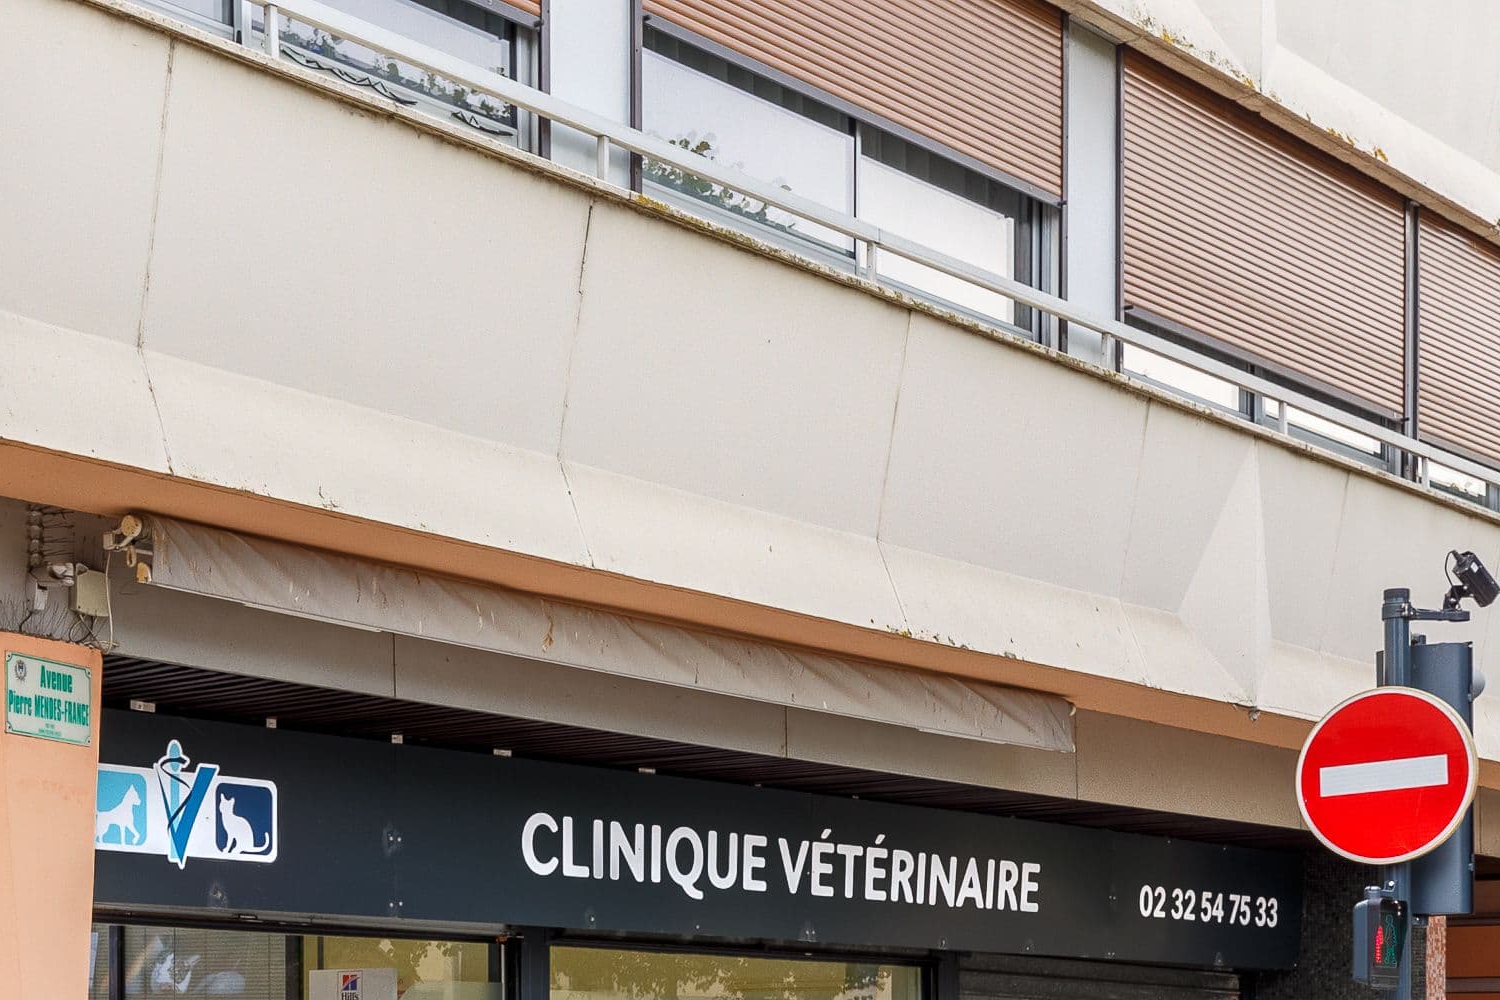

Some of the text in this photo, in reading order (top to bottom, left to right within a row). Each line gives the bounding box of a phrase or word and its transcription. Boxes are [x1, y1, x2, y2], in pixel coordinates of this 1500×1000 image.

[40, 665, 73, 694] Avenue
[8, 689, 33, 716] Pierre
[521, 812, 1278, 928] CLINIQUE VÉTÉRINAIRE 02 32 54 75 33
